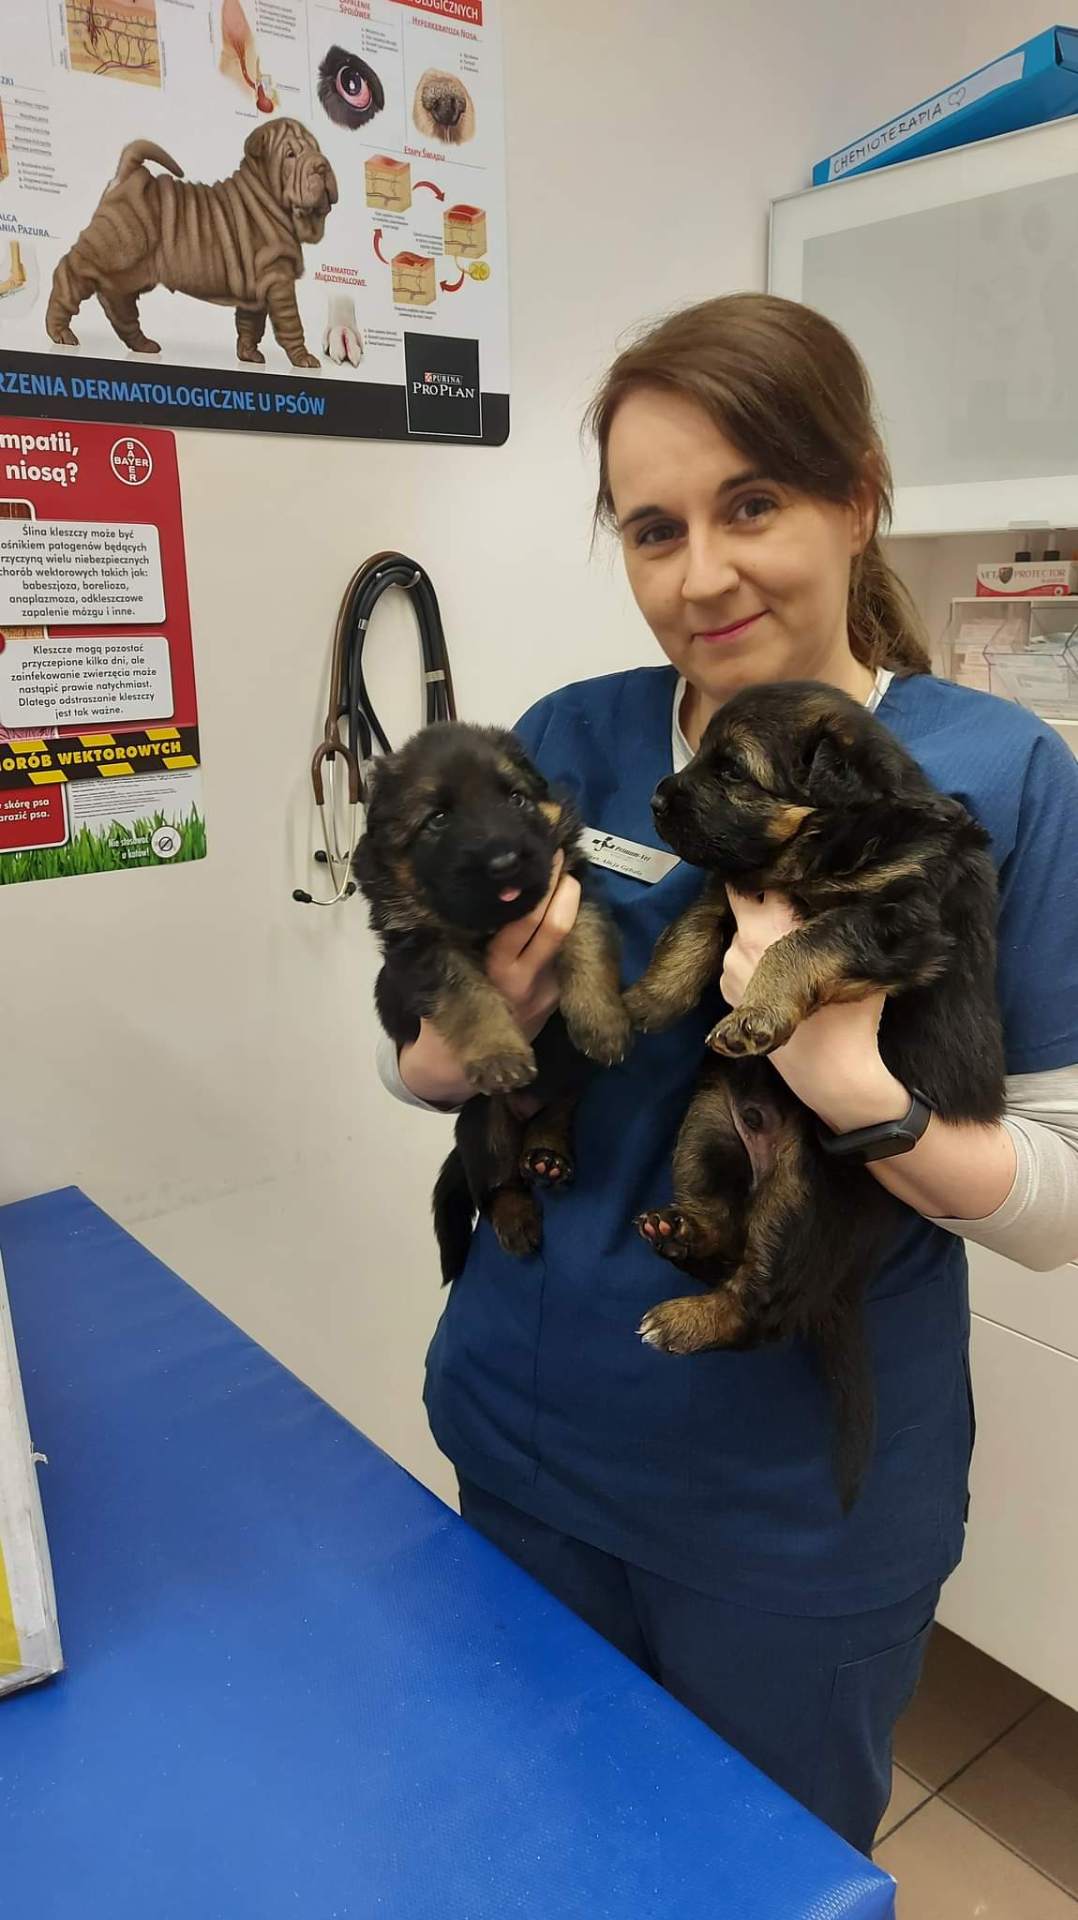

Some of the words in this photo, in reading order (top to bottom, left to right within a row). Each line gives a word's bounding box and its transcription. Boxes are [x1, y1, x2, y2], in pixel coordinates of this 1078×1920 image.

[833, 102, 943, 175] CHEMIOTERAPIA
[71, 377, 256, 411] DERMATOLOGICZNE
[259, 394, 271, 412] U
[275, 391, 325, 416] PSÓW
[0, 431, 79, 457] mpatii,
[114, 456, 149, 468] BAYER
[6, 460, 79, 487] niosą?
[22, 524, 47, 536] Ślina
[50, 526, 88, 539] kleszczy
[91, 528, 116, 538] może
[118, 529, 135, 540] być
[48, 541, 102, 552] patogenów
[104, 542, 147, 553] będących
[46, 554, 72, 564] wielu
[75, 554, 150, 566] niebezpiecznych
[35, 567, 98, 579] wektorowych
[101, 568, 129, 577] takich
[131, 568, 148, 579] jak:
[22, 580, 80, 592] babeszjoza,
[82, 580, 129, 591] borelioza,
[9, 594, 79, 606] anaplazmoza,
[81, 594, 144, 603] odkleszczowe
[22, 606, 69, 618] zapalenie
[72, 606, 104, 618] mózgu
[112, 606, 136, 616] inne.
[33, 646, 73, 654] Kleszcze
[75, 646, 102, 655] mogą
[105, 643, 144, 655] pozostać
[22, 657, 84, 670] przyczepione
[86, 656, 109, 665] kilka
[111, 655, 129, 666] dni,
[131, 655, 145, 664] ale
[11, 669, 81, 681] zainfekowanie
[83, 667, 130, 679] zwierzęcia
[132, 667, 157, 676] może
[19, 683, 59, 695] nastąpić
[61, 681, 93, 693] prawie
[96, 680, 153, 692] natychmiast.
[18, 697, 56, 708] Dlatego
[59, 693, 117, 705] odstraszanie
[119, 691, 155, 702] kleszczy
[55, 708, 72, 720] jest
[74, 707, 89, 716] tak
[91, 705, 124, 716] ważne.
[57, 741, 181, 766] WEKTOROWYCH
[4, 799, 30, 809] skórę
[32, 799, 50, 808] psa
[30, 811, 50, 821] psa.
